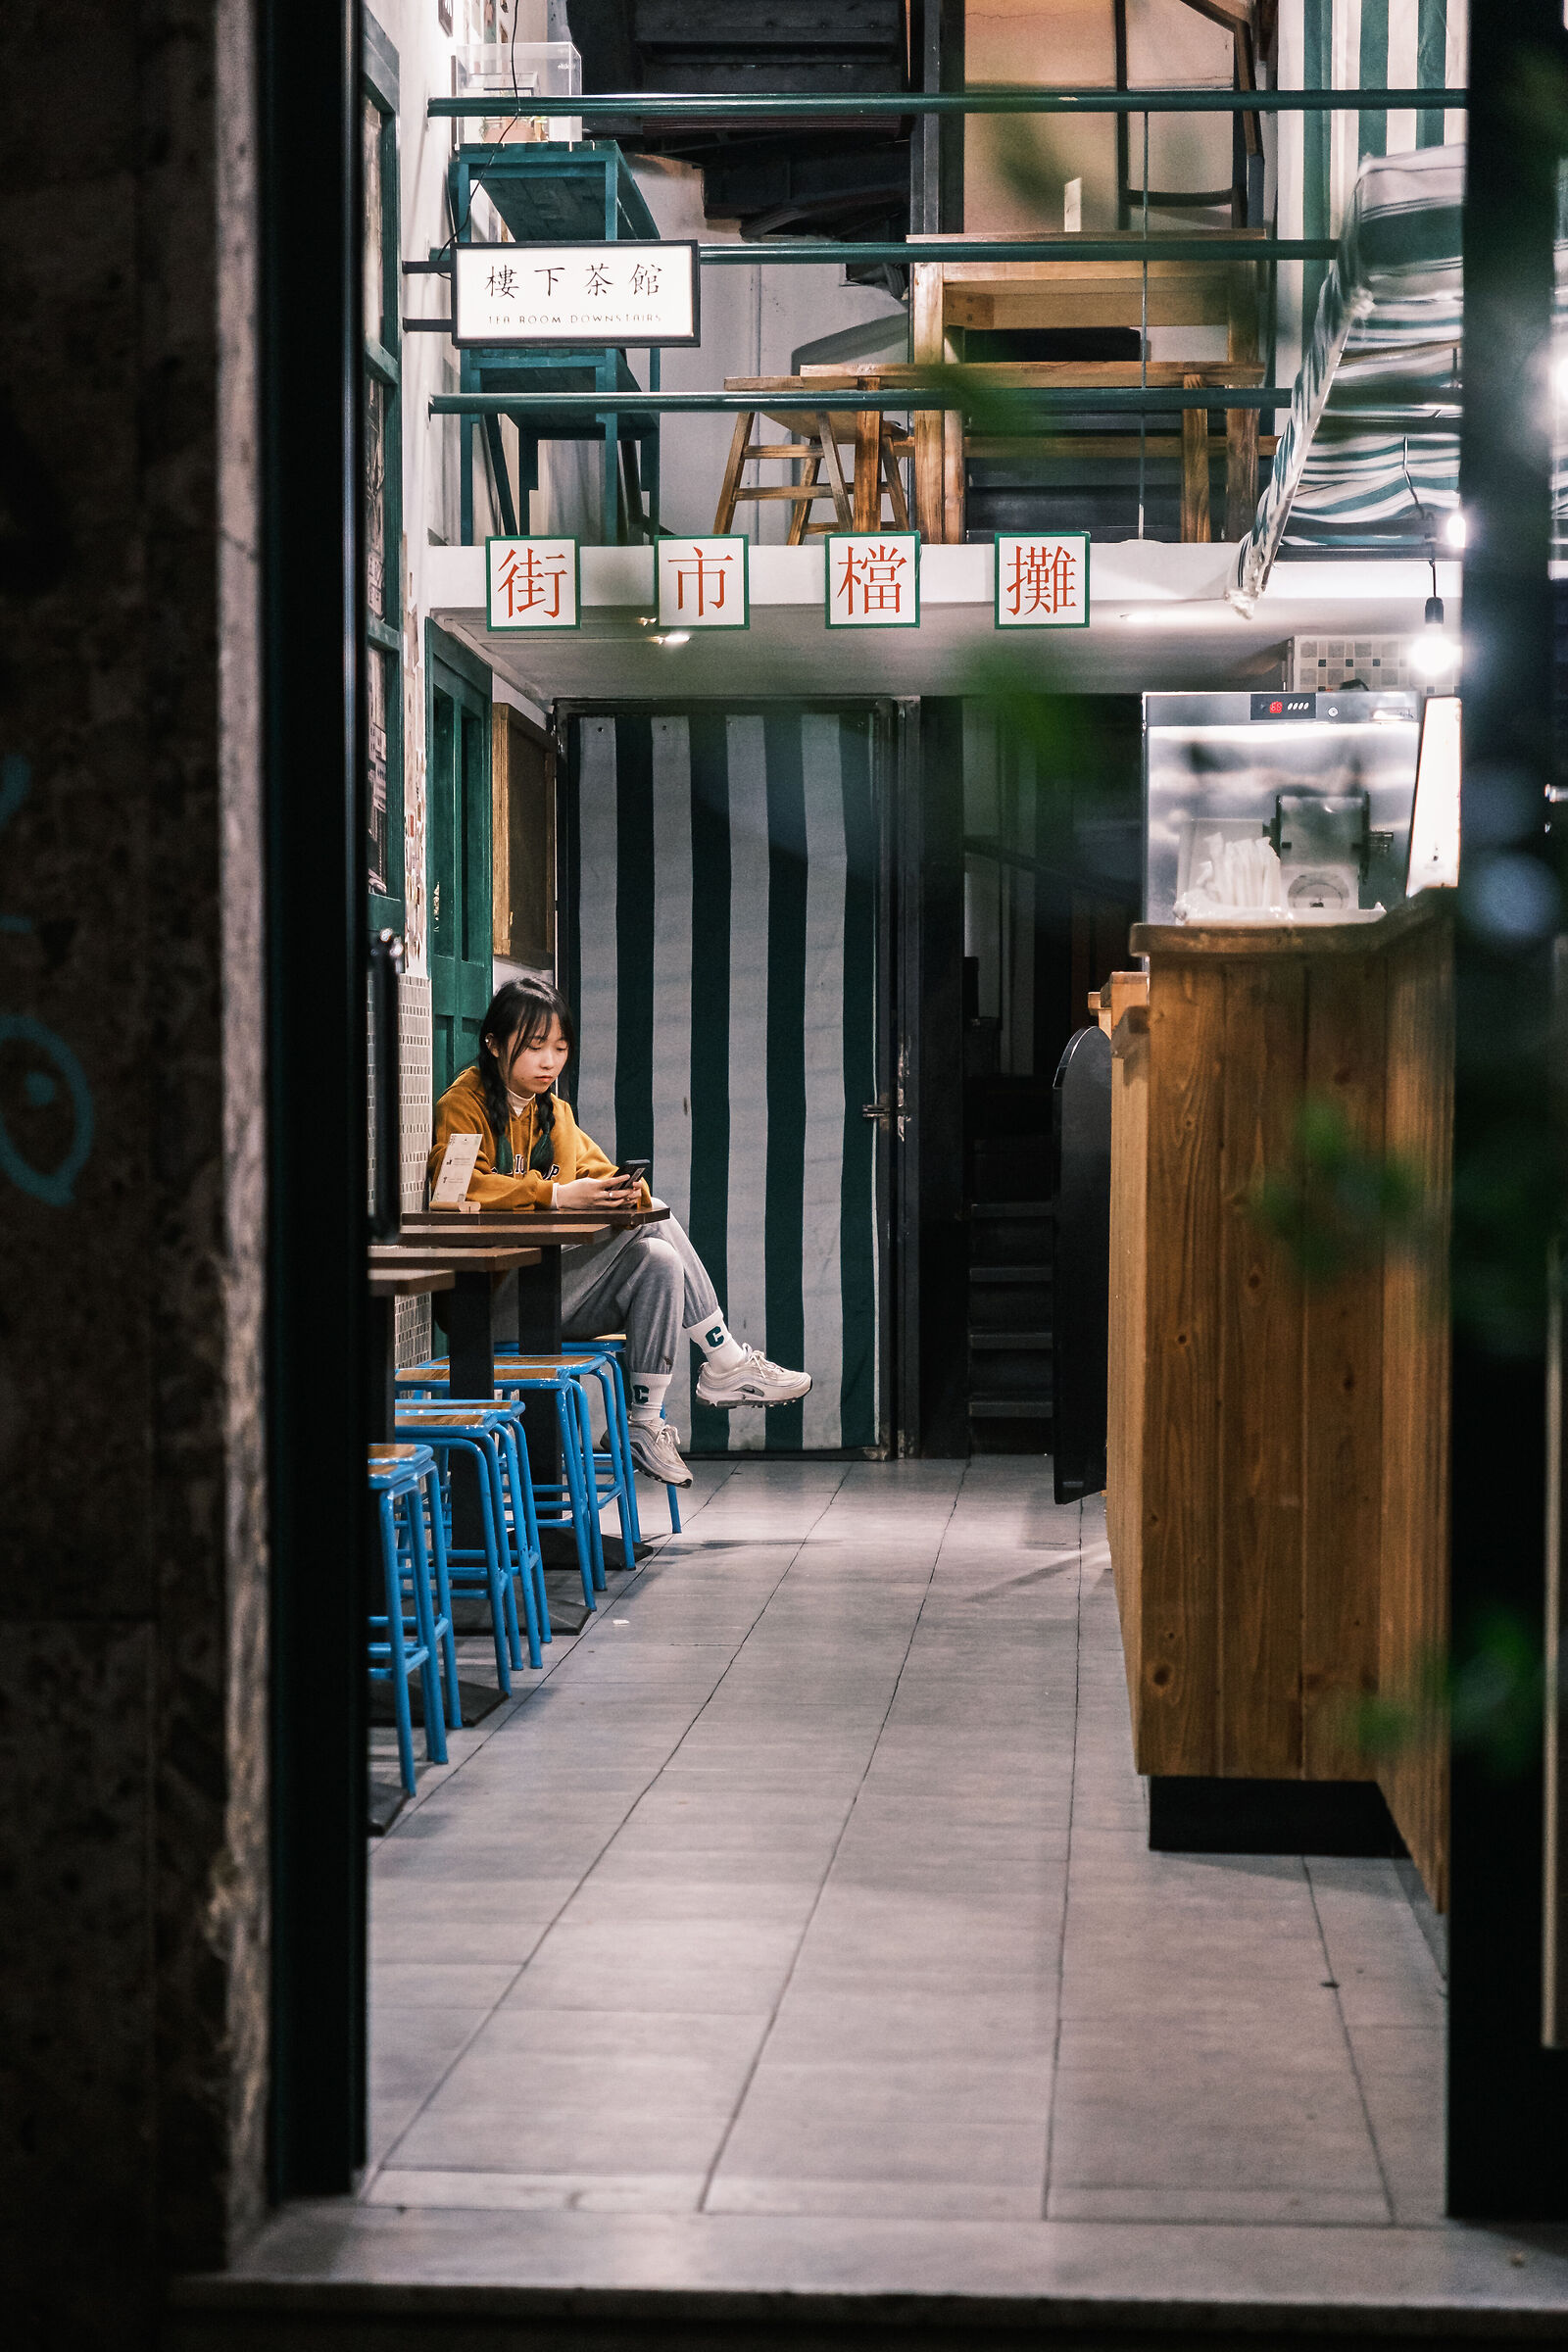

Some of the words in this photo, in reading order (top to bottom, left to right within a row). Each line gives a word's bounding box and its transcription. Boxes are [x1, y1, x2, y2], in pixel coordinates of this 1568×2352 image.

[485, 263, 662, 299] 樓下茶館
[519, 315, 562, 324] ROOM
[571, 313, 662, 324] DOWNSTAIRS
[497, 544, 1078, 619] 街市檔攤
[705, 1325, 725, 1348] C
[632, 1384, 651, 1404] C
